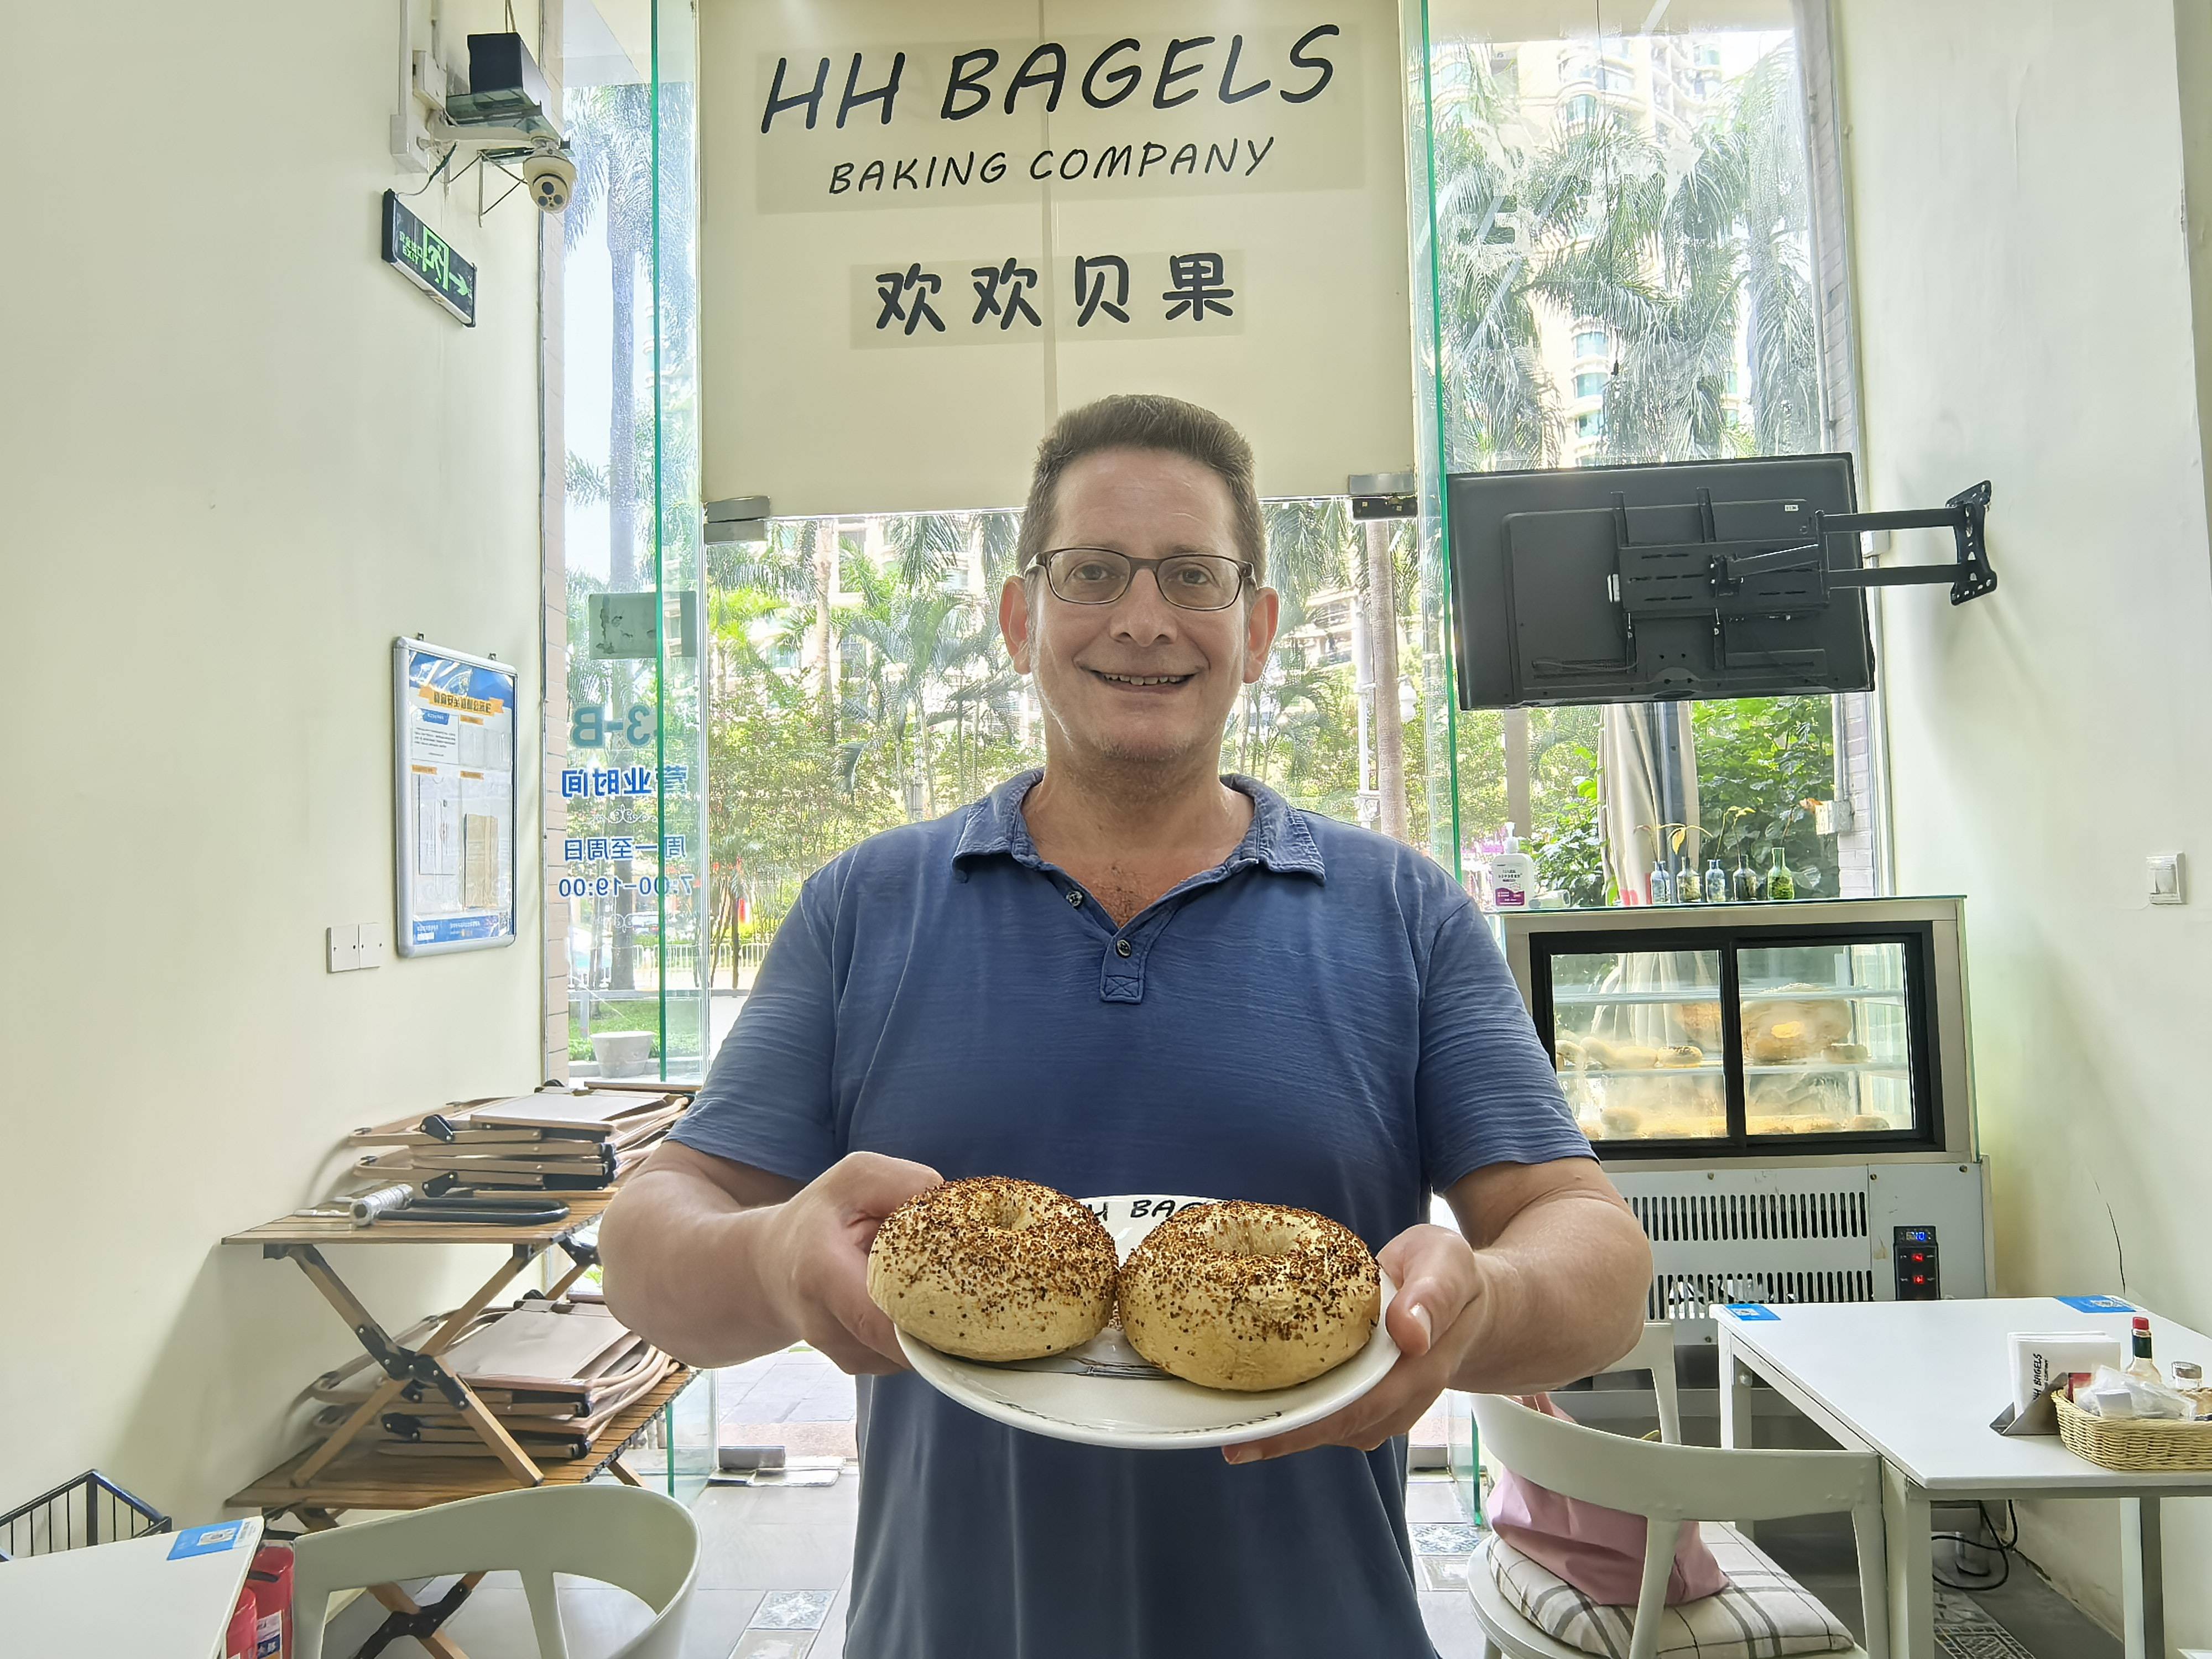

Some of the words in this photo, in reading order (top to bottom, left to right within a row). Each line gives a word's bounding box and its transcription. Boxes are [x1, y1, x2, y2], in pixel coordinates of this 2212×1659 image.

[761, 53, 905, 133] HH
[940, 24, 1339, 120] BAGELS
[830, 152, 1006, 195] BAKING
[1030, 137, 1274, 180] COMPANY
[403, 244, 419, 264] EXIT
[876, 253, 1233, 335] 欢欢贝果
[2033, 1353, 2042, 1386] BAGELS
